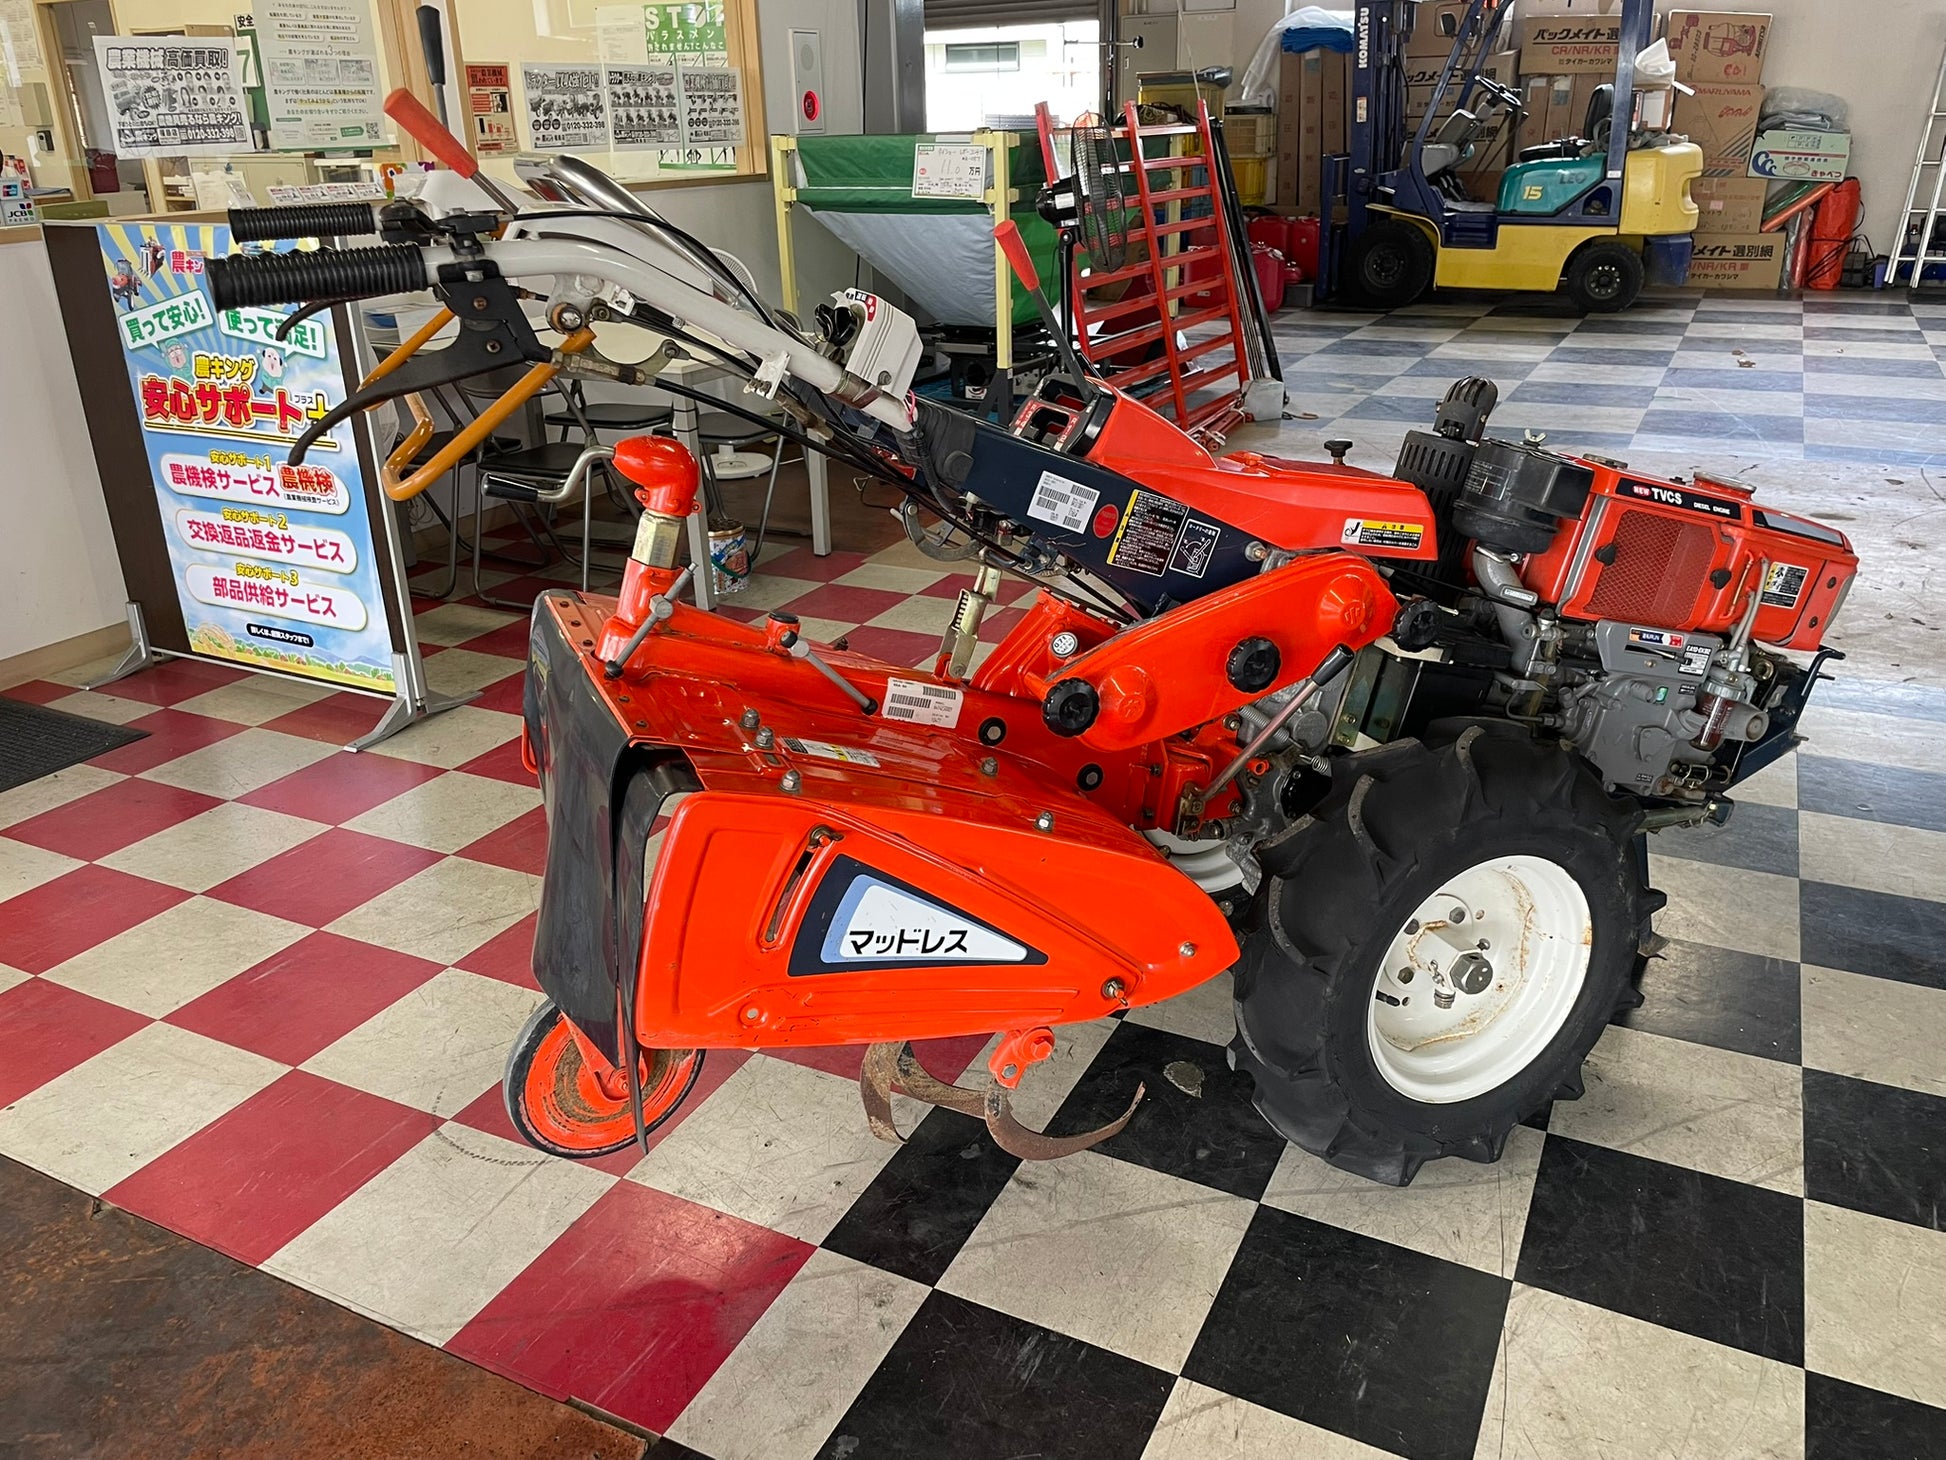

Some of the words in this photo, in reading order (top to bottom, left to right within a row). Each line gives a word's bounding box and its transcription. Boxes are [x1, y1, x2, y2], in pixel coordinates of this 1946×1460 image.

[1358, 7, 1370, 68] KOMATSU
[1697, 87, 1752, 96] MARUYAMA
[968, 166, 981, 176] 万円
[1522, 186, 1543, 200] 15
[8, 210, 28, 218] JCB
[1692, 245, 1774, 257] メイト選別網
[1690, 262, 1737, 271] /NR/KR
[125, 298, 206, 343] 買って安心!
[194, 355, 256, 380] 農キング
[141, 378, 303, 430] 安心サポート
[169, 463, 280, 497] 農機検サービス
[280, 466, 336, 494] 農機検
[1633, 484, 1651, 496] NEW
[1651, 487, 1683, 506] TVCS
[1693, 502, 1711, 512] DIESEL
[1713, 506, 1731, 515] ENGINE
[187, 519, 345, 563] 交換返品返金サービス
[212, 576, 337, 618] 部品供給サービス
[848, 929, 970, 956] マッドレス
